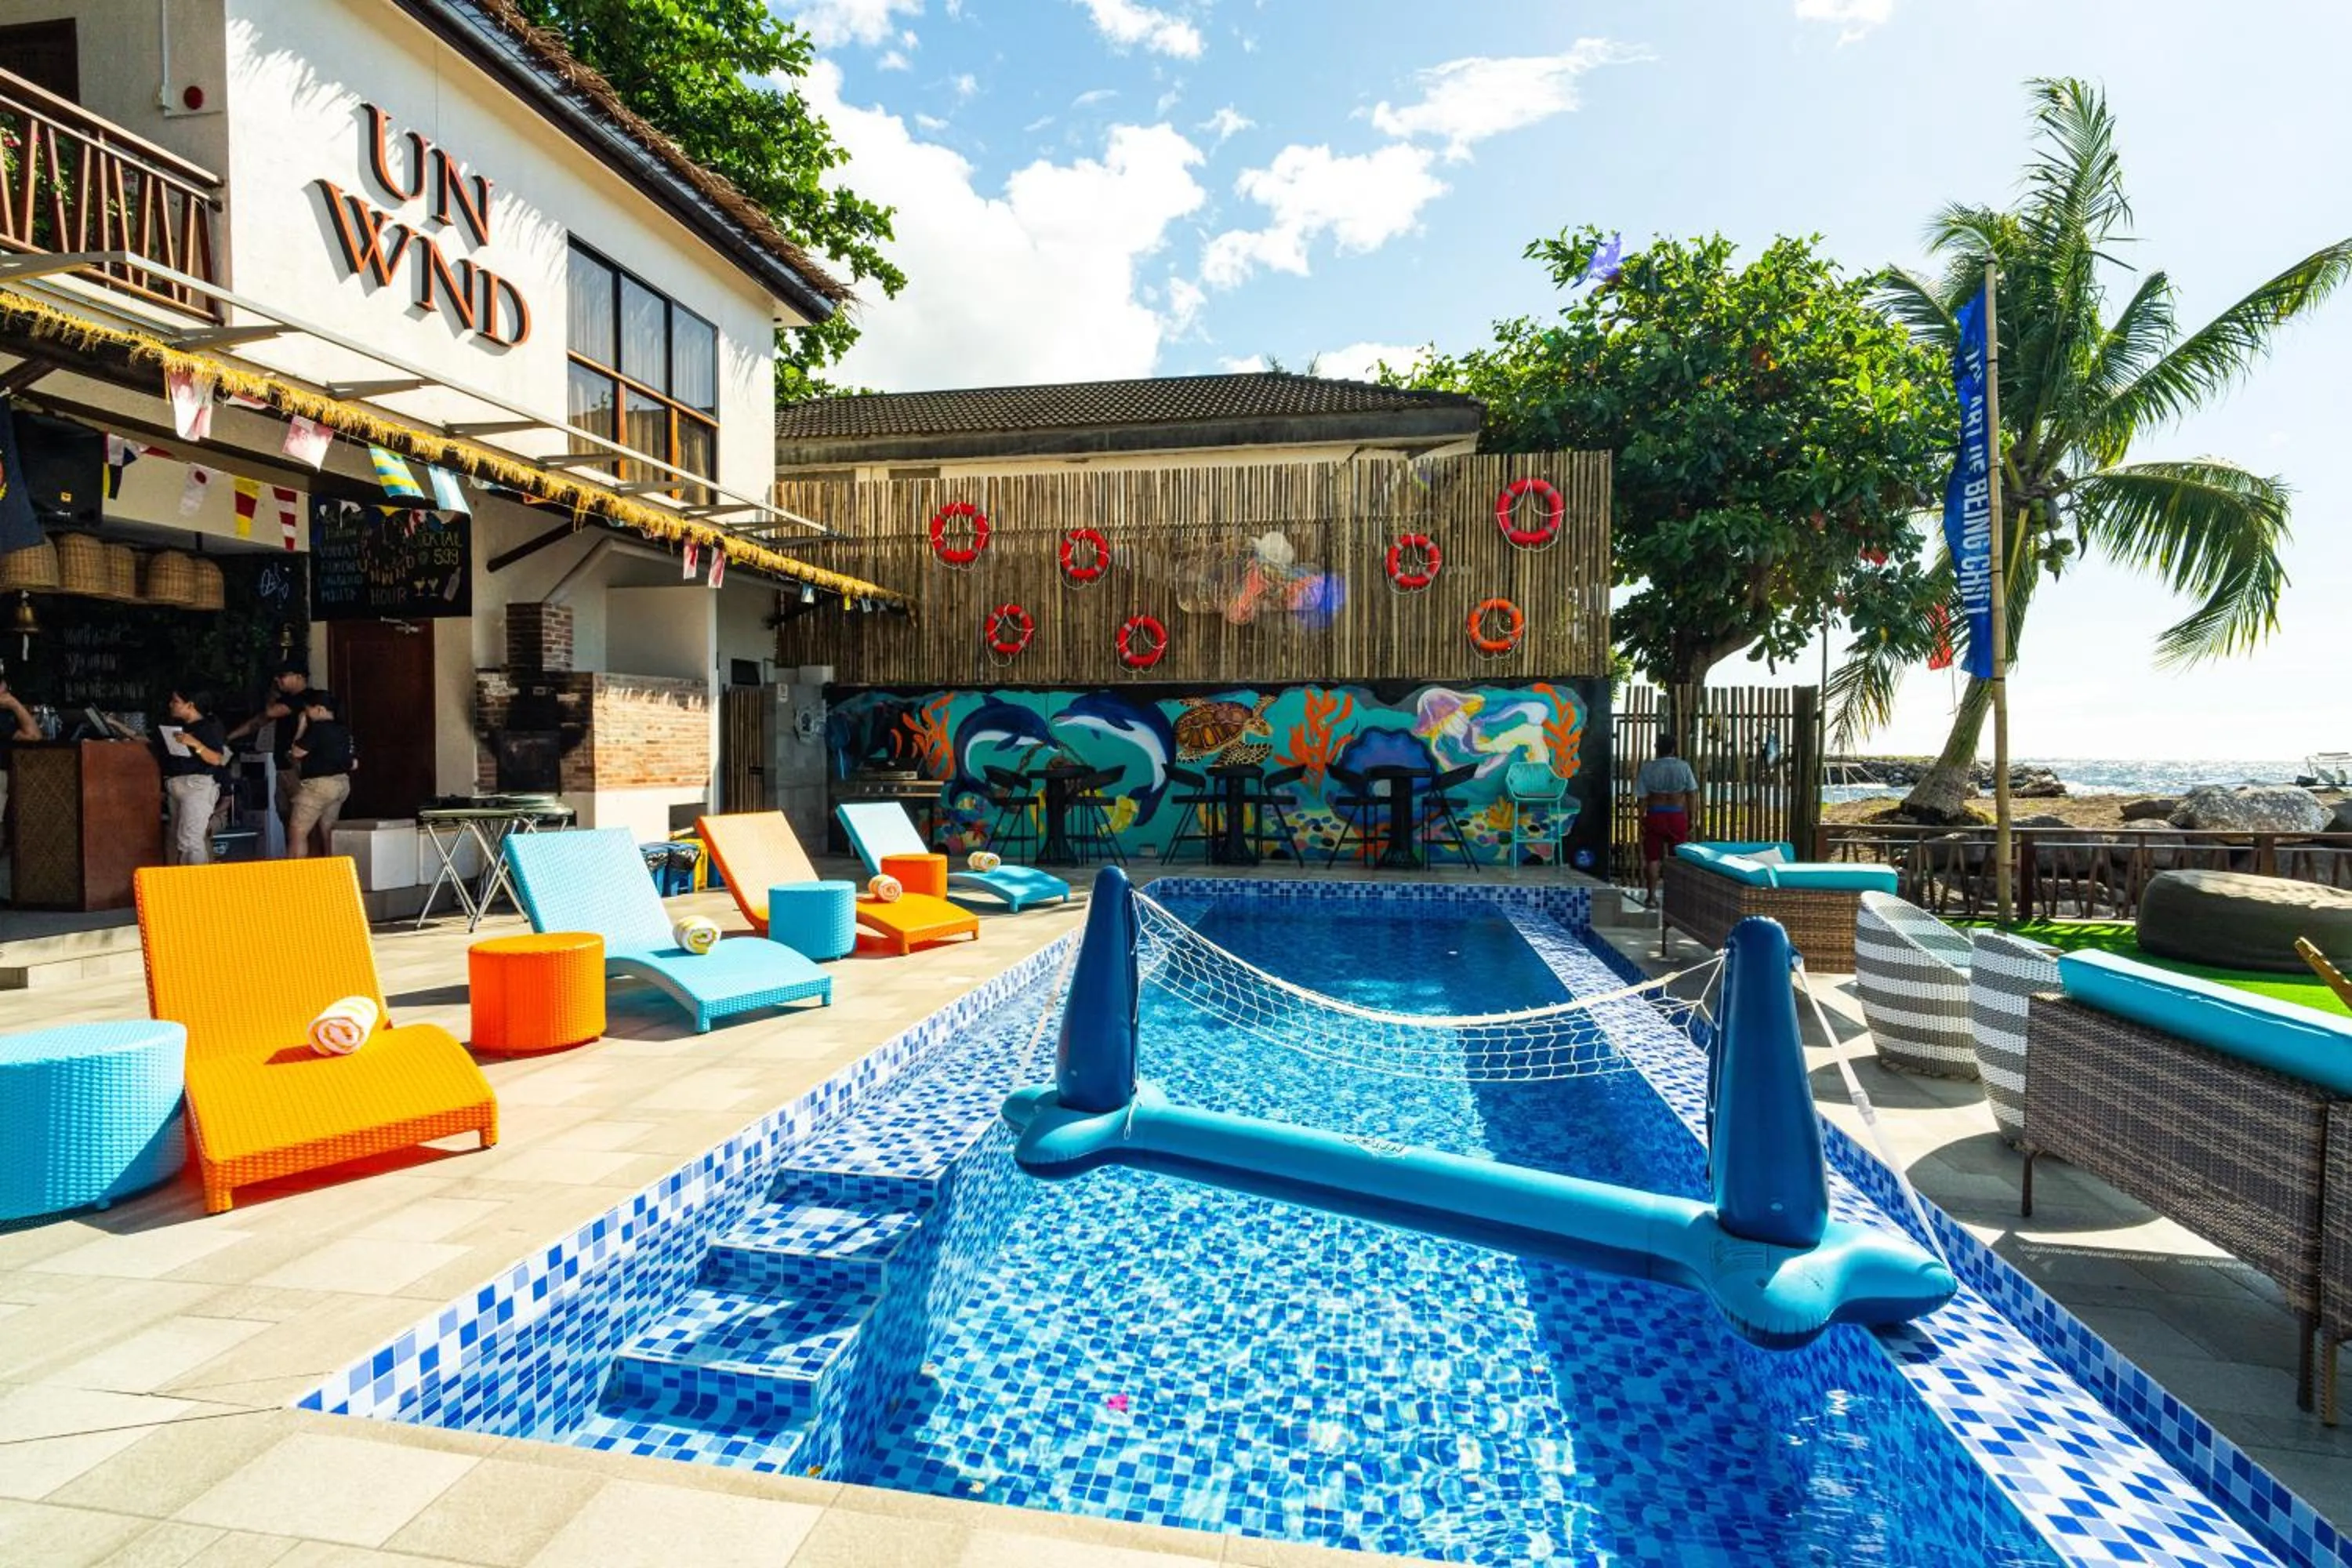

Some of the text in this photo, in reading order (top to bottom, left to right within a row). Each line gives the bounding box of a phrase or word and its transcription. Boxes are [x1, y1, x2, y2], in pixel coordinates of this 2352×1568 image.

[361, 103, 495, 247] UN
[314, 179, 532, 347] WND
[1962, 477, 1991, 550] BEING
